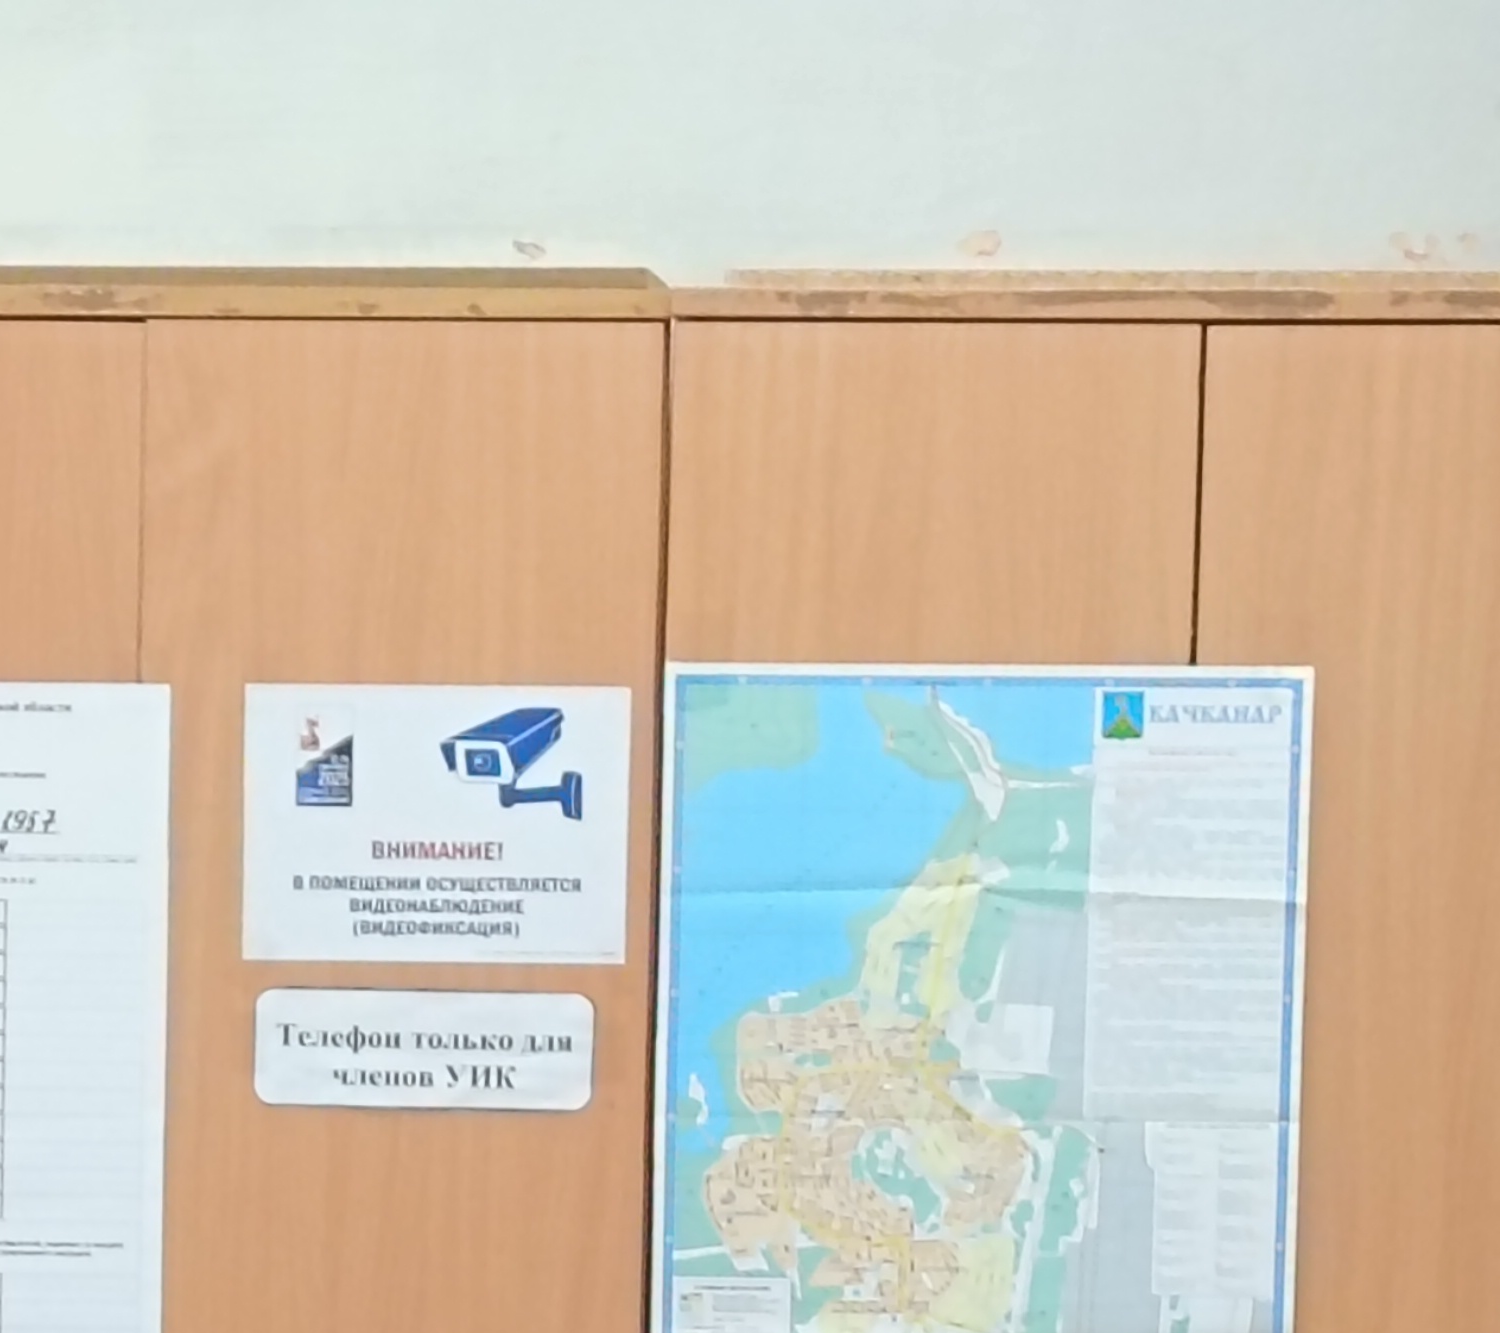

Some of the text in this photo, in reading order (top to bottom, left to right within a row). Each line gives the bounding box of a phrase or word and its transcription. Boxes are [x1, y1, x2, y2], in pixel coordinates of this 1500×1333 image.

[1150, 705, 1283, 723] КАЧКАНАР
[1, 809, 56, 834] 1957
[372, 840, 503, 860] ВНИМАНИЕ!
[293, 876, 582, 893] В ПОМЕЩЕНИИ ОСУЩЕСТВЛЯЕТСЯ
[349, 899, 525, 915] ВИДЕОНАБЛЮДЕНИЕ
[353, 920, 520, 938] (ВИДЕОФИКСАЦИЯ)
[277, 1023, 573, 1053] Телефон только для
[333, 1065, 516, 1089] членов УИК
